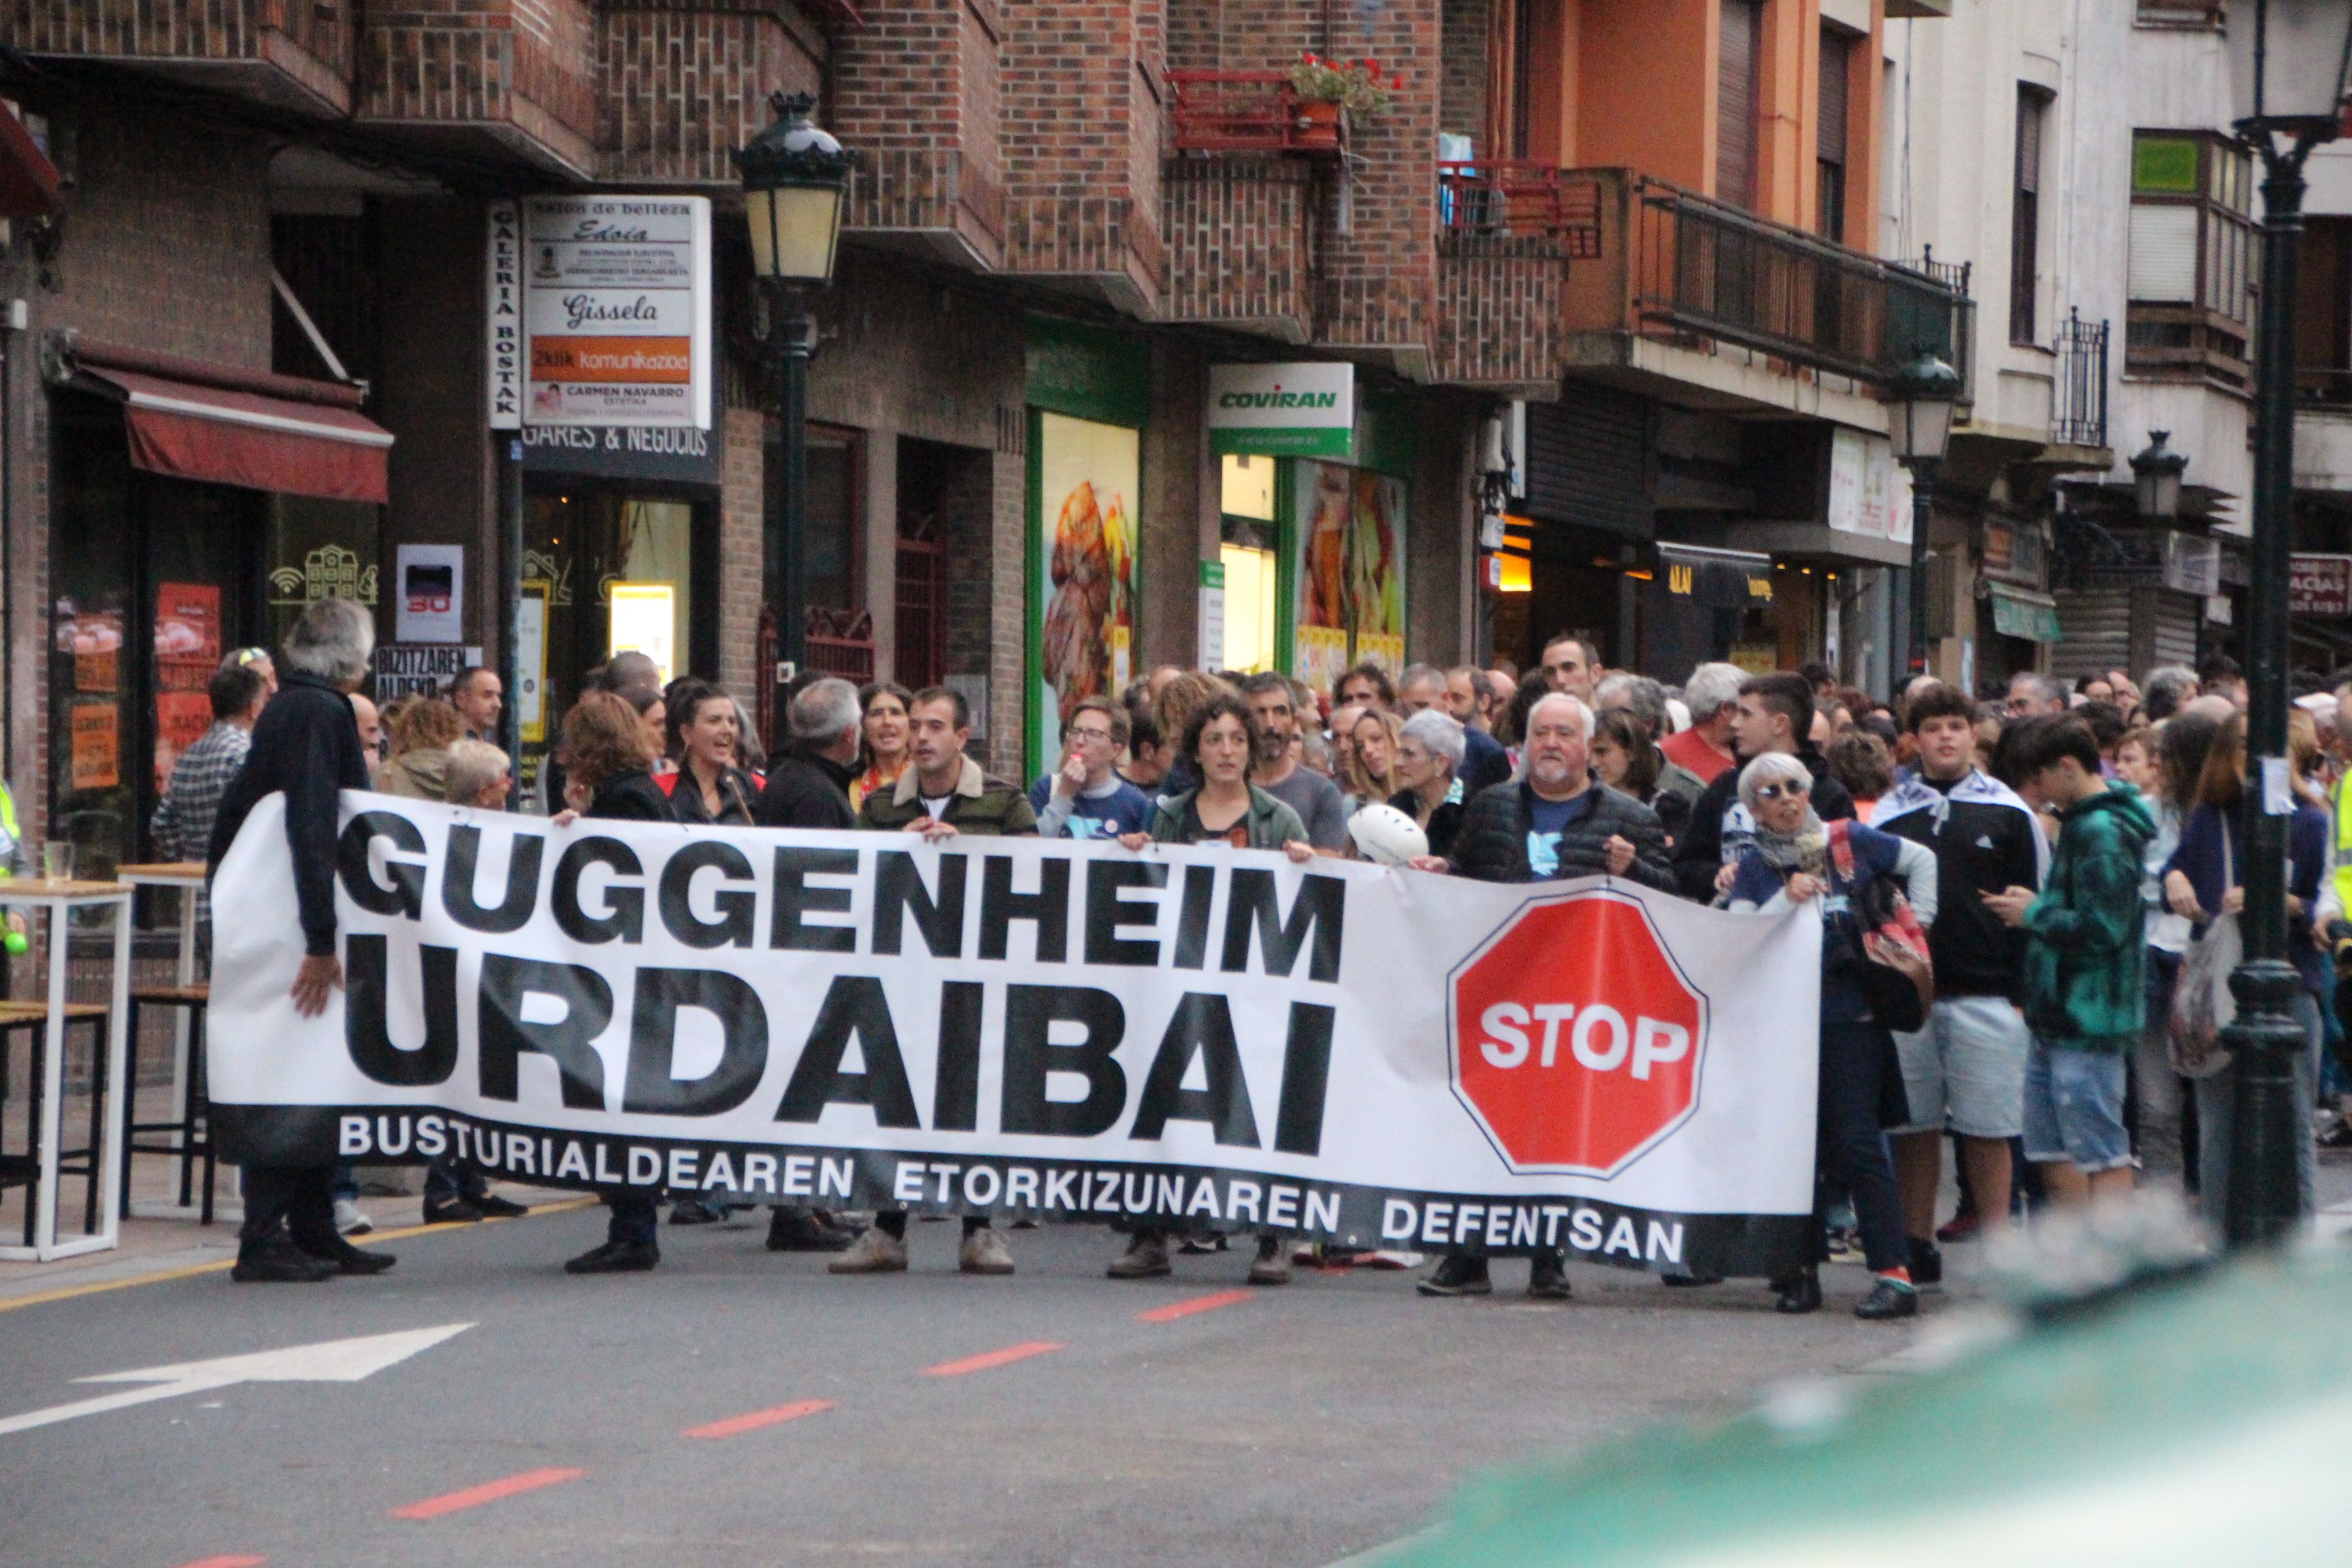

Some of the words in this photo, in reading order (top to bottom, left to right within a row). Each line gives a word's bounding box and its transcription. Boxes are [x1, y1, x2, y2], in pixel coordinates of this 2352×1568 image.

[494, 212, 514, 314] GALERIA
[562, 294, 658, 329] Gissela
[495, 326, 515, 414] BOSTAK
[566, 385, 620, 397] CARMEN
[623, 386, 684, 398] NAVARRO
[580, 350, 688, 370] komunikazioa
[406, 596, 451, 612] 30
[339, 811, 1346, 984] GUGGENHEIM
[344, 934, 1336, 1157] URDAIBAI
[1480, 1002, 1690, 1081] STOP
[340, 1115, 855, 1199] BUSTURIALDEAREN
[894, 1163, 1340, 1234] ETORKIZUNAREN
[1382, 1198, 1684, 1264] DEFENTSAN
